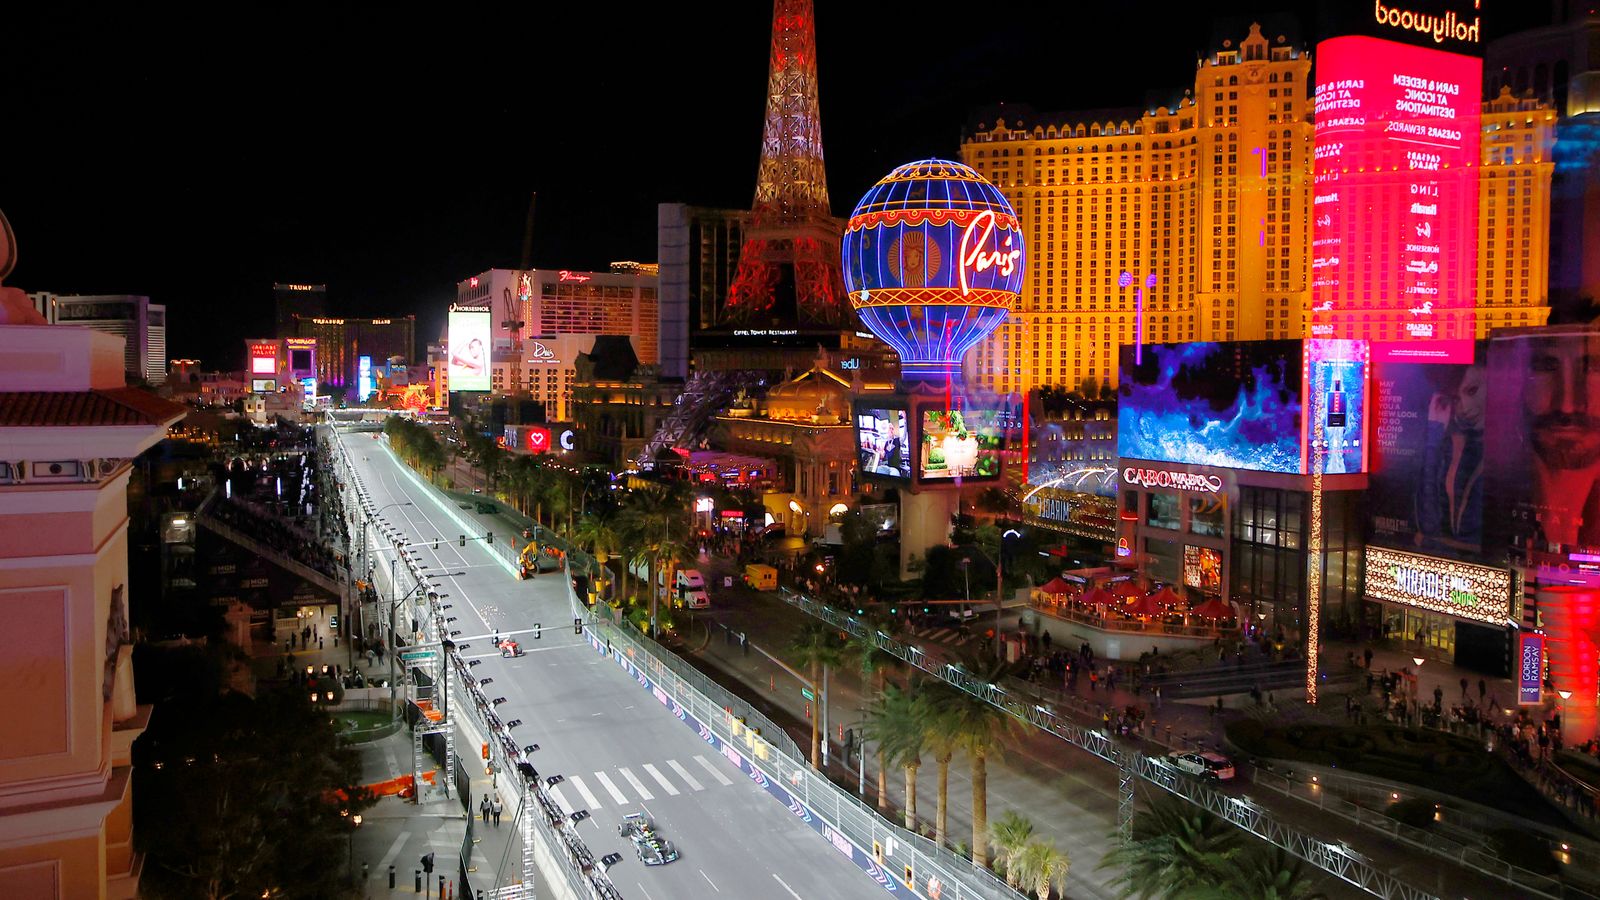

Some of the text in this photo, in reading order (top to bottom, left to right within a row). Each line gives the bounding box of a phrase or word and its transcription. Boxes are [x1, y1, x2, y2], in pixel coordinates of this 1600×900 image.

[960, 210, 1020, 296] Paris
[1123, 468, 1212, 489] CABO WABO
[1397, 567, 1450, 602] MIRACLE
[1451, 590, 1477, 608] SHOPS
[1523, 646, 1539, 680] GORDON RAMSAY
